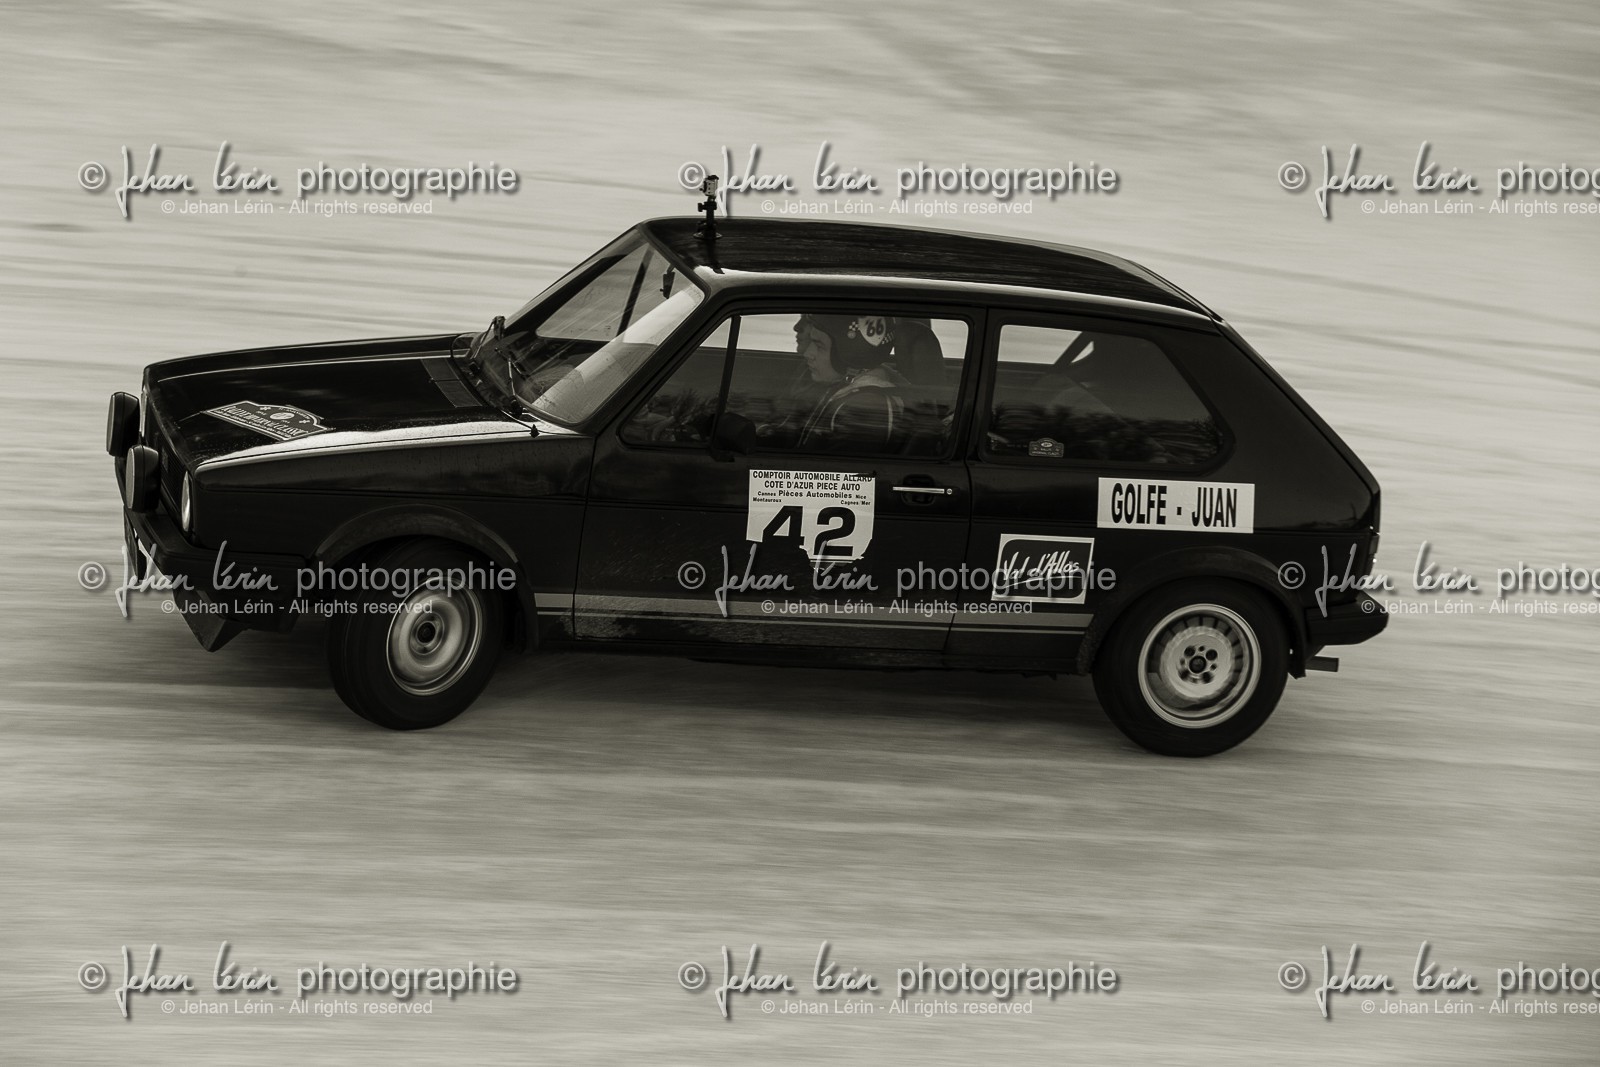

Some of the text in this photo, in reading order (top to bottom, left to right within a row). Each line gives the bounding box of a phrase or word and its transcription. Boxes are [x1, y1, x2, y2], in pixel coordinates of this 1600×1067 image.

[752, 470, 791, 480] COMPTOIR
[794, 472, 841, 482] AUTOMOBILE
[764, 480, 861, 491] COTE D'AZUR PIECE AUTO
[778, 490, 804, 498] Pièces
[806, 491, 853, 499] Automobiles
[1111, 482, 1167, 525] GOLFE
[1191, 486, 1238, 528] JUAN
[761, 505, 856, 557] 42
[1003, 551, 1031, 581] Val
